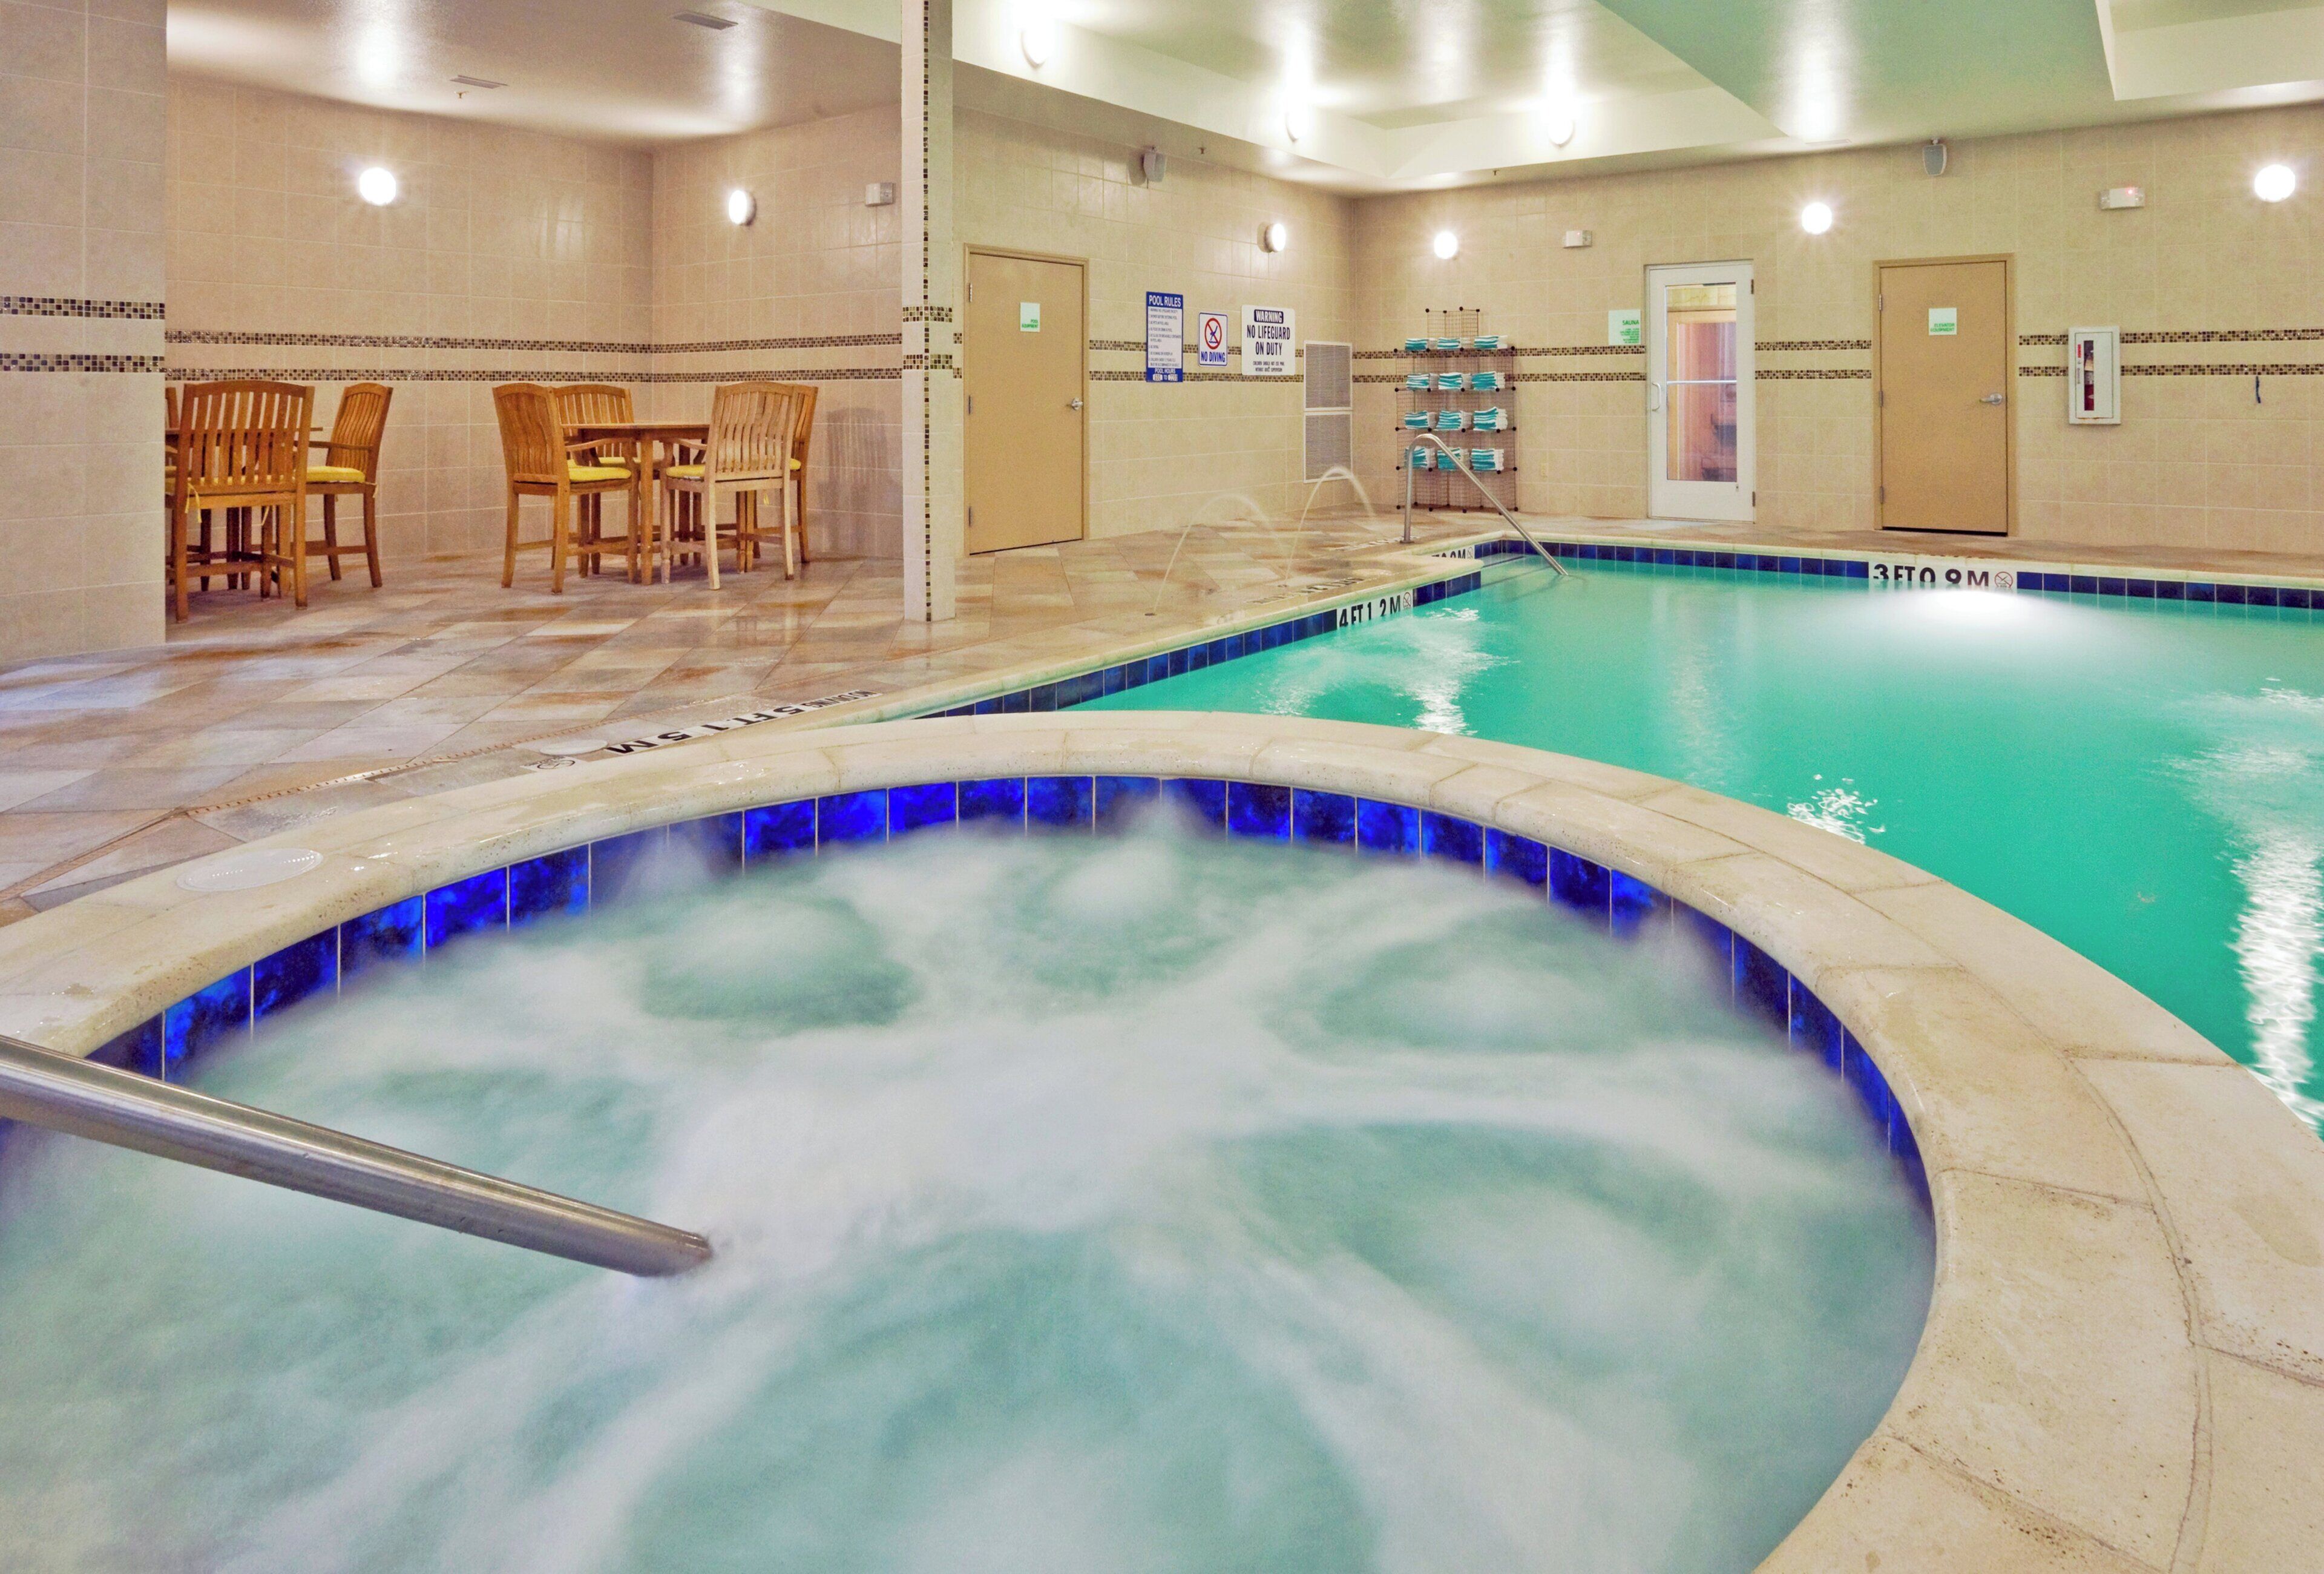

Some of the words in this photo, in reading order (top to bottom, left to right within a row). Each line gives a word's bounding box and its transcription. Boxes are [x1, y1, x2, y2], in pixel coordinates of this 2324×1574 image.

[1149, 295, 1163, 306] POOL
[1164, 296, 1181, 308] RULES
[1256, 310, 1282, 323] WARNING
[1247, 324, 1256, 338] NO
[1258, 326, 1290, 340] LIFEGUARD
[1255, 341, 1264, 355] ON
[1266, 342, 1282, 356] DUTY
[1201, 351, 1208, 362] NO
[1209, 352, 1226, 363] DIVING
[1339, 608, 1348, 627] 4
[801, 695, 858, 708] DIVING
[773, 705, 803, 715] 5
[606, 740, 657, 754] M
